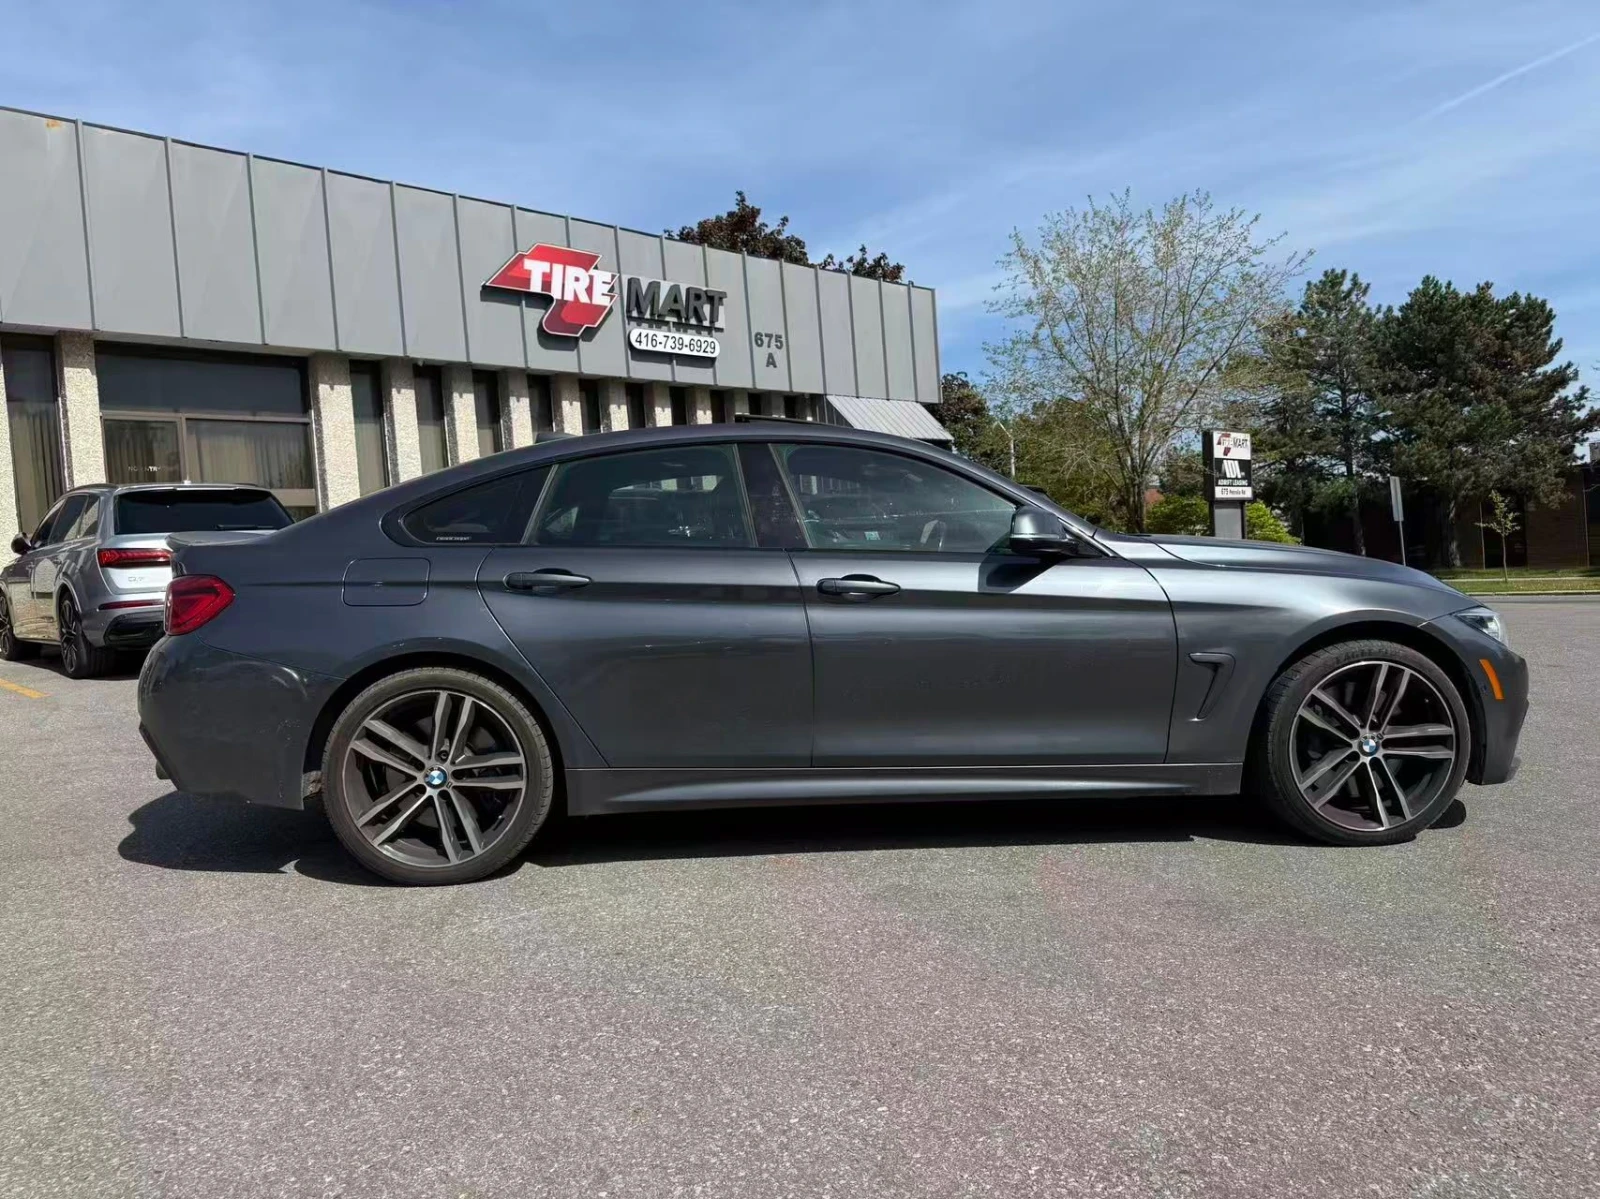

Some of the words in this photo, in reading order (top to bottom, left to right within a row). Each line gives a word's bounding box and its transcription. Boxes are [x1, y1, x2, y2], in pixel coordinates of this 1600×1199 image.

[523, 258, 613, 306] TIRE
[626, 277, 727, 325] MART
[635, 331, 717, 355] 416-739-6929
[754, 331, 784, 350] 675
[765, 352, 778, 368] A
